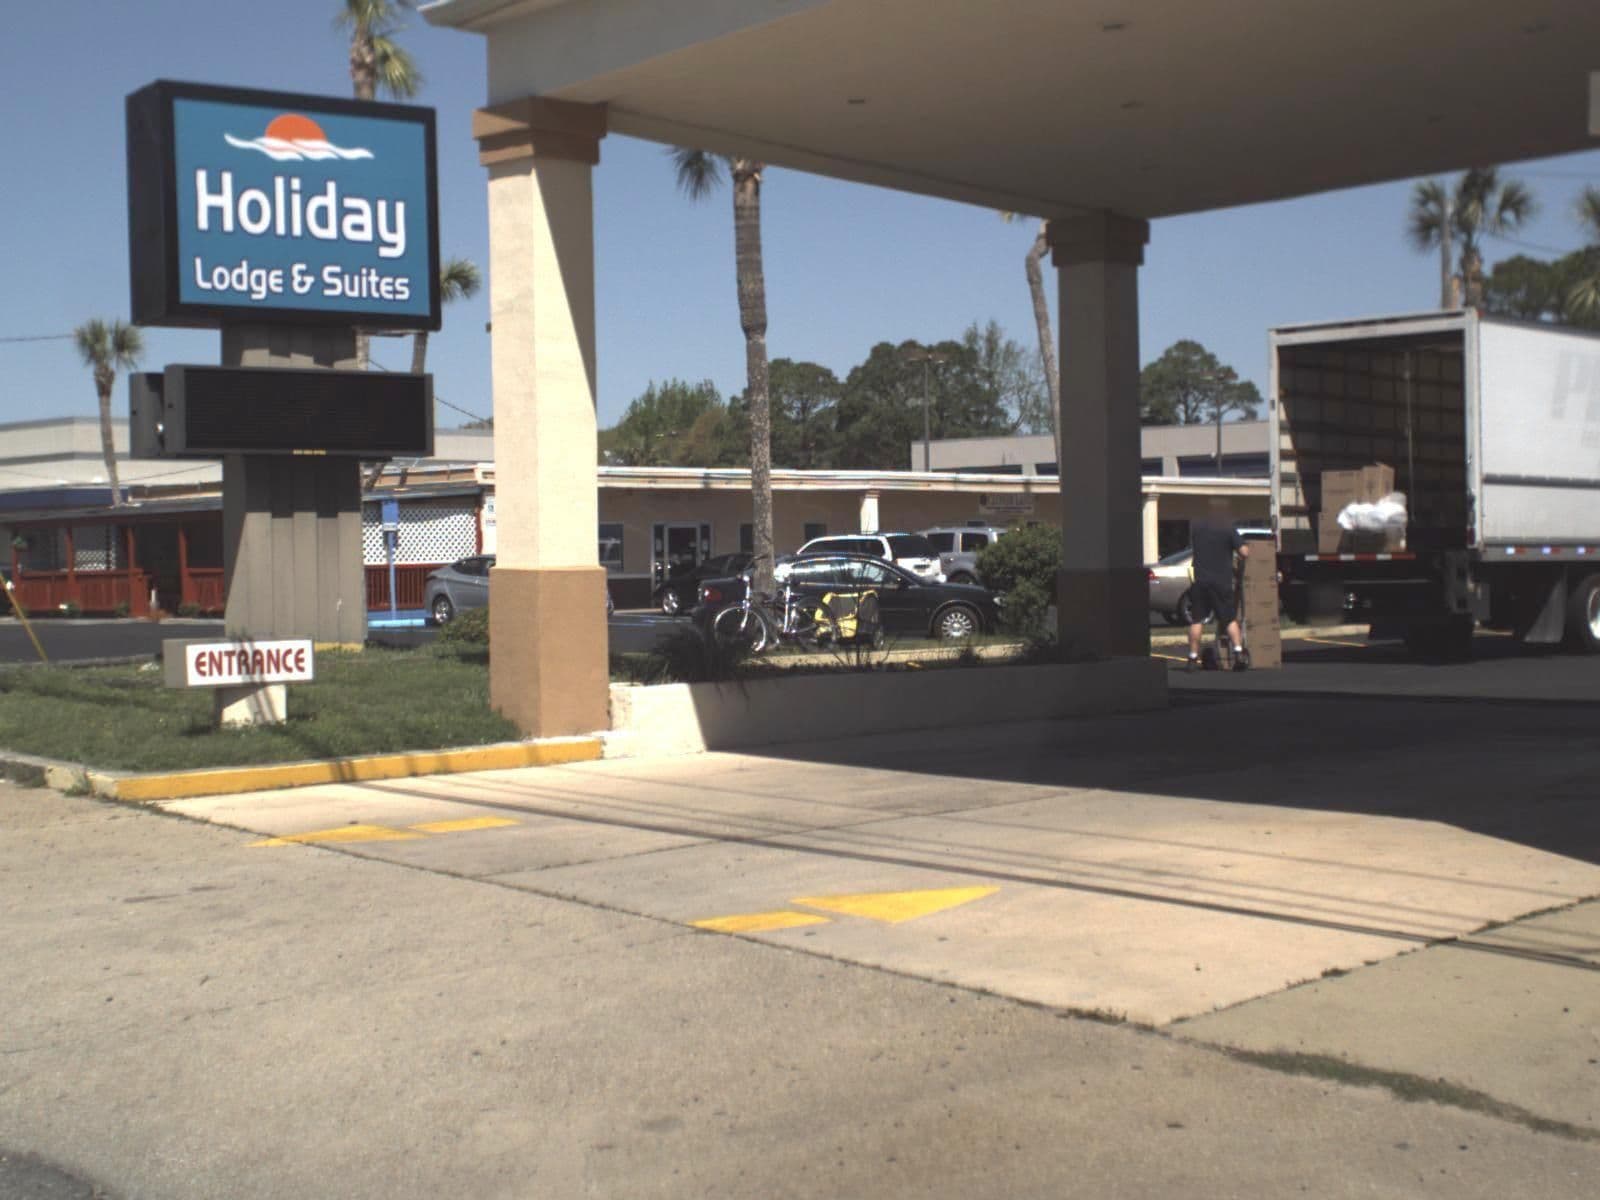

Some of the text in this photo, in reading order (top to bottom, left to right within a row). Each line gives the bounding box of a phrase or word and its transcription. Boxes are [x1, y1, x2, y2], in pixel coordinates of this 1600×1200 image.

[196, 169, 406, 257] Holiday
[195, 258, 410, 300] Lodge & Suites
[195, 648, 305, 676] ENTRANCE
